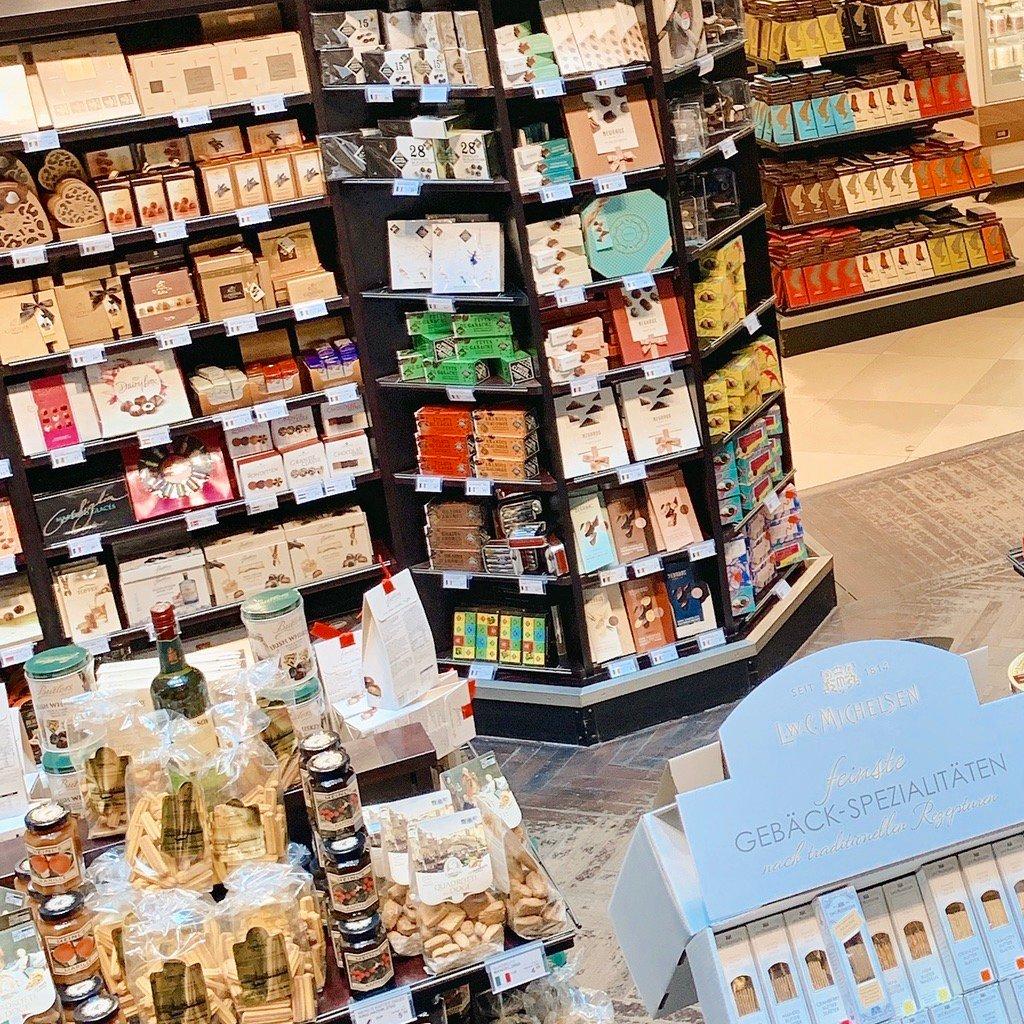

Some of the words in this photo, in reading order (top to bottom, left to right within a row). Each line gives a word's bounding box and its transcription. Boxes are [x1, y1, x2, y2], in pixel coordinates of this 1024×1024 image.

[409, 144, 426, 158] 28
[460, 141, 476, 154] 28
[819, 683, 921, 730] MICHELSEN
[734, 752, 1008, 853] GEBÄCK-SPEZIALITÄTEN
